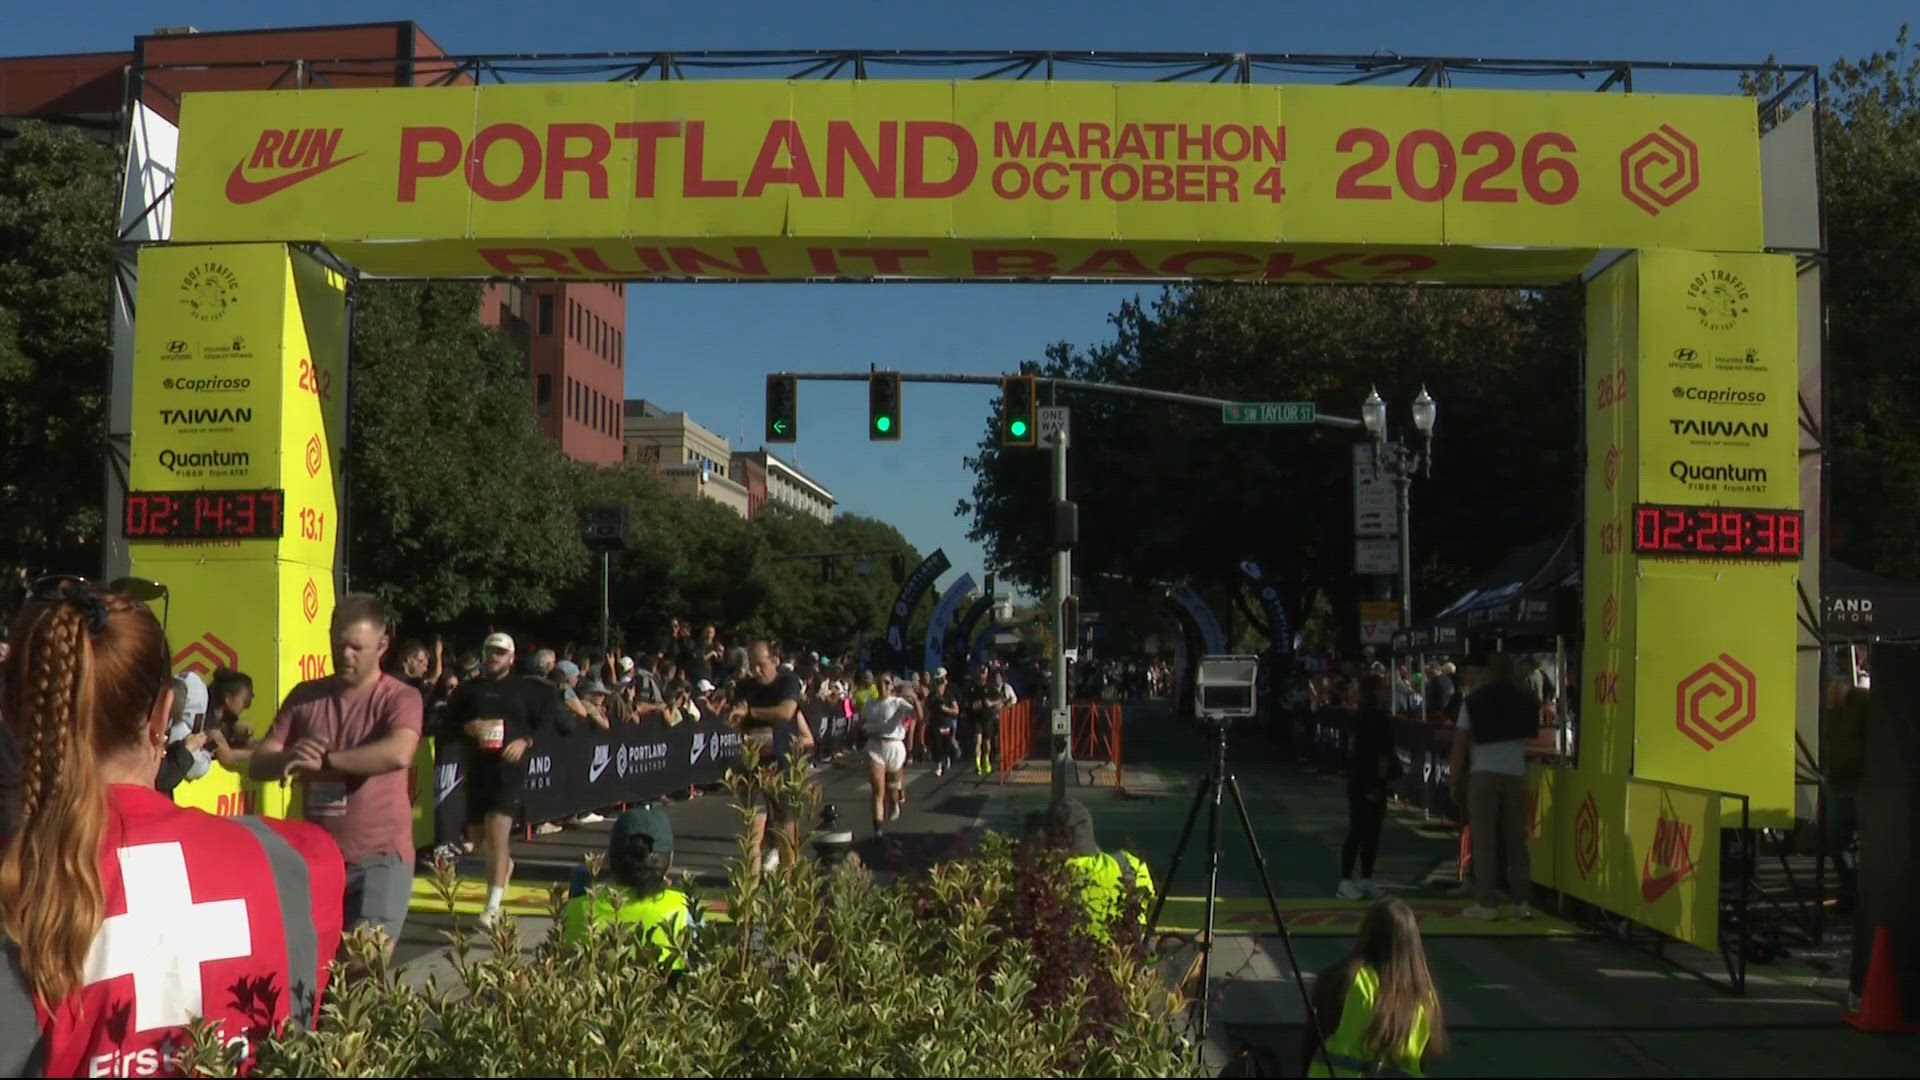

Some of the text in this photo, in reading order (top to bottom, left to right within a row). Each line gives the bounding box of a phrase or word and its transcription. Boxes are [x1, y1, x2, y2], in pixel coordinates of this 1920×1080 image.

[247, 127, 344, 169] RUN
[993, 121, 1287, 162] MARATHON
[397, 119, 979, 202] PORTLAND
[1335, 127, 1580, 206] 2026
[992, 163, 1286, 204] OCTOBER 4
[477, 246, 770, 275] RUN
[806, 247, 929, 275] IT
[181, 262, 239, 291] FOOT TRAFFIC
[1687, 269, 1749, 300] FOOT TRAFFIC
[175, 375, 251, 392] Capriroso
[299, 358, 331, 400] 26.2
[1598, 367, 1626, 410] 26.2
[1686, 387, 1766, 403] Capriroso
[159, 407, 252, 425] TAIWAN
[1041, 410, 1064, 420] ONE
[1041, 420, 1065, 431] WAY
[1244, 405, 1312, 421] SW TAYLOR ST
[1670, 419, 1769, 438] TAIWAN
[159, 449, 249, 472] Quantum
[1670, 460, 1767, 484] Quantum
[127, 493, 281, 535] 02:14:37
[299, 506, 325, 542] 13.1
[1600, 519, 1623, 555] 13.1
[1637, 509, 1800, 554] 02:29:38
[299, 653, 328, 681] 10K
[1594, 672, 1619, 704] 10K
[629, 742, 668, 761] PORTLAND
[1651, 816, 1693, 872] RUN
